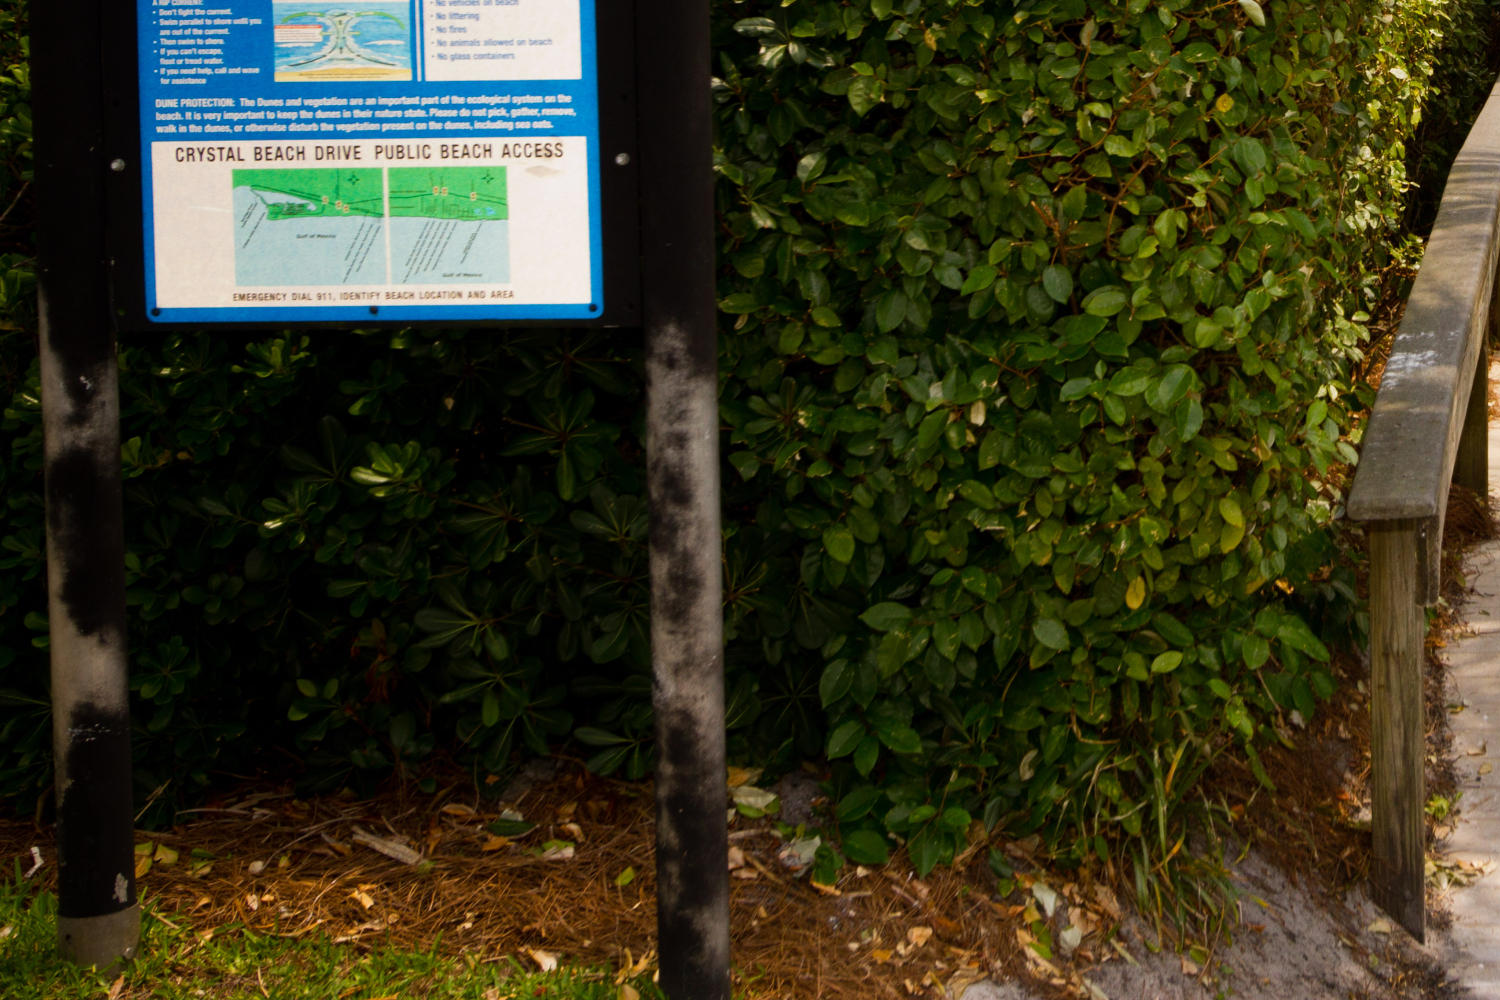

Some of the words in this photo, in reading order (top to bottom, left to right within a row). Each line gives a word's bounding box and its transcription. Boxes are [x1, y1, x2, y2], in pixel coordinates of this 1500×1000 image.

[156, 98, 177, 107] DUNE
[180, 98, 234, 107] PROTECTION:
[175, 146, 244, 162] CRYSTAL
[254, 146, 305, 161] BEACH
[315, 145, 360, 160] DRIVE
[375, 144, 430, 159] PUBLIC
[440, 143, 491, 158] BEACH
[502, 142, 562, 158] ACCESS
[232, 292, 287, 301] EMERGENCY
[291, 292, 312, 300] DIAL
[339, 292, 380, 300] IDENTIFY
[384, 291, 414, 299] BEACH
[418, 291, 462, 299] LOCATION
[467, 290, 485, 298] AND
[490, 290, 513, 298] AREA
